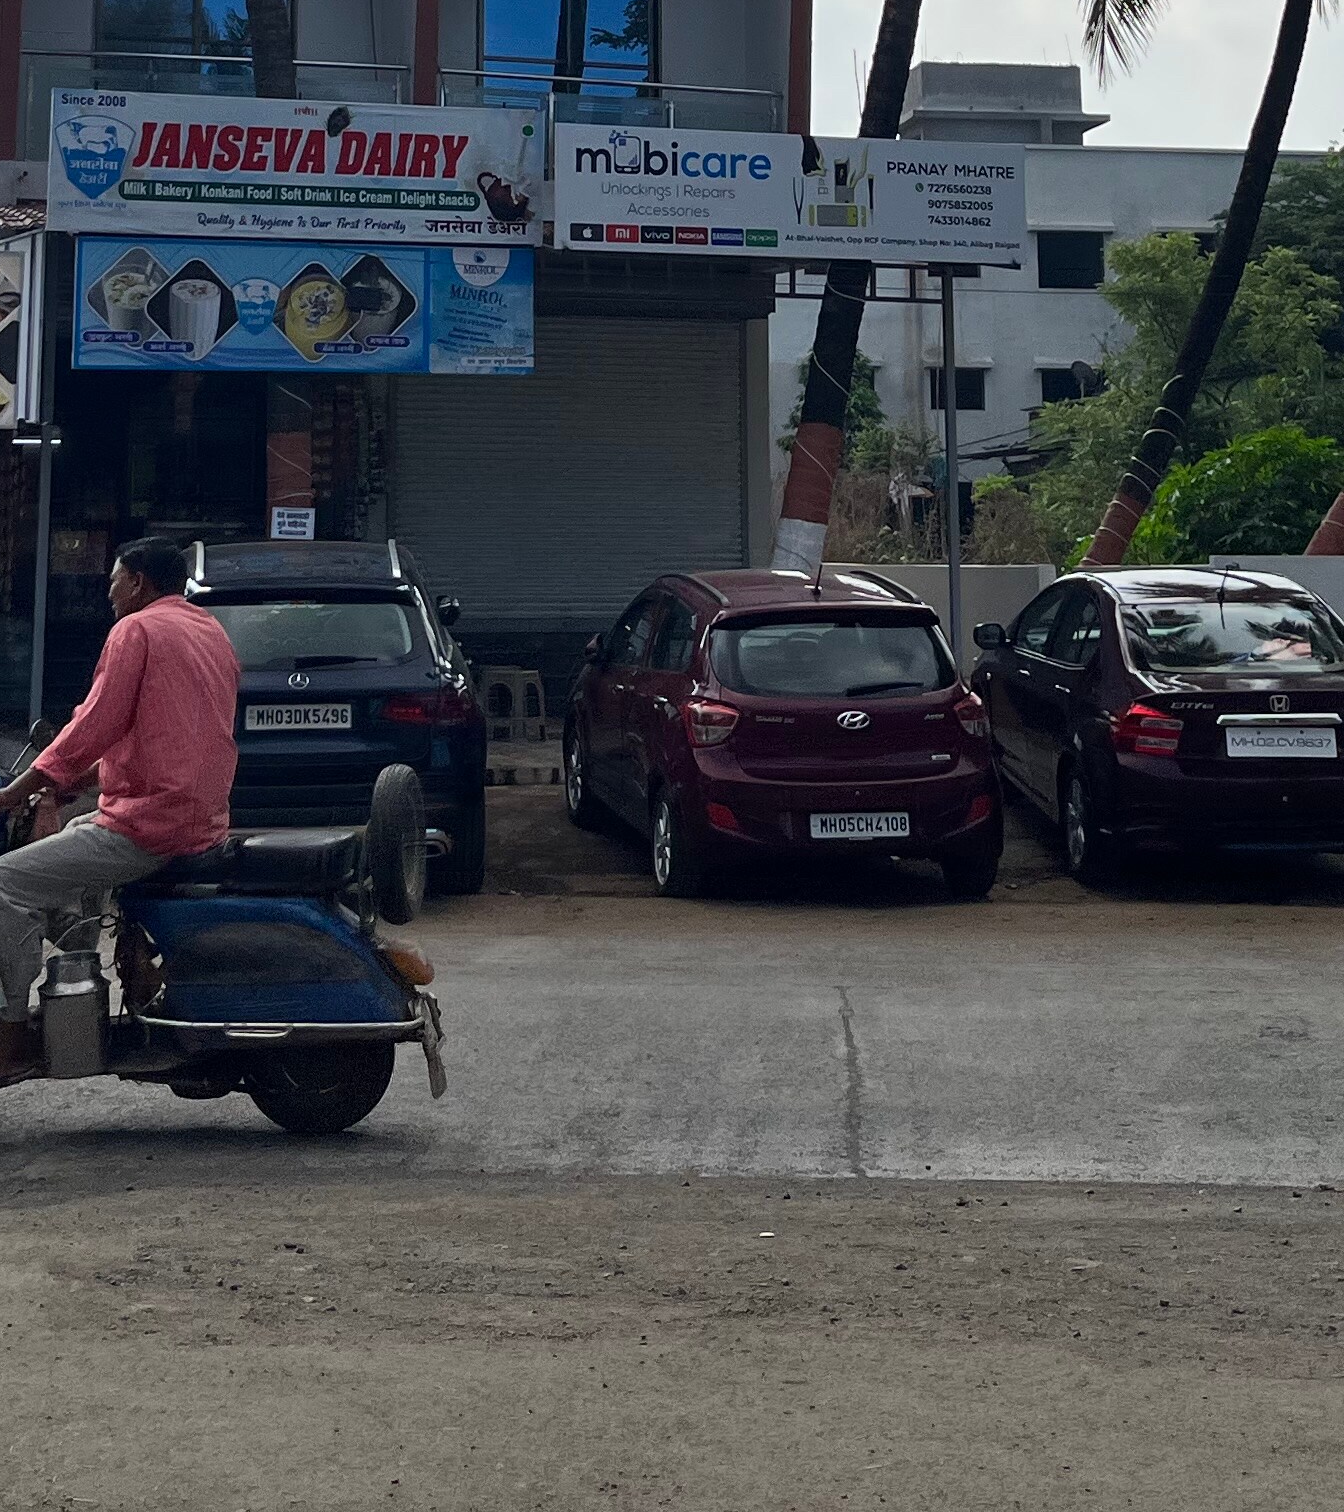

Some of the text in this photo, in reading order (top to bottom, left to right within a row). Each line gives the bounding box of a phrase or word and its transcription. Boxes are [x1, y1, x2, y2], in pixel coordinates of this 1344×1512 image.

[61, 93, 127, 108] Since 2008
[132, 122, 469, 179] JANSEVA DAIRY
[886, 161, 1015, 180] PRANAY MHATRE
[123, 181, 475, 208] Milk Bakery Konkani Food Soft Drink Ice Cream Delight Snacks
[601, 182, 736, 201] Unlockings Repairs
[927, 183, 992, 196] 7276560238
[626, 202, 710, 219] Accessories
[927, 199, 994, 212] 9075852005
[197, 212, 235, 229] Quality
[239, 215, 248, 226] &
[251, 214, 294, 230] Hygiene
[310, 216, 331, 230] Our
[336, 217, 360, 230] First
[364, 217, 407, 234] Priority
[424, 216, 528, 236] जनसेवा डेअरी
[927, 215, 992, 228] 7433014862
[256, 708, 349, 726] MH03DK5496
[819, 816, 908, 833] MH05CH4108
